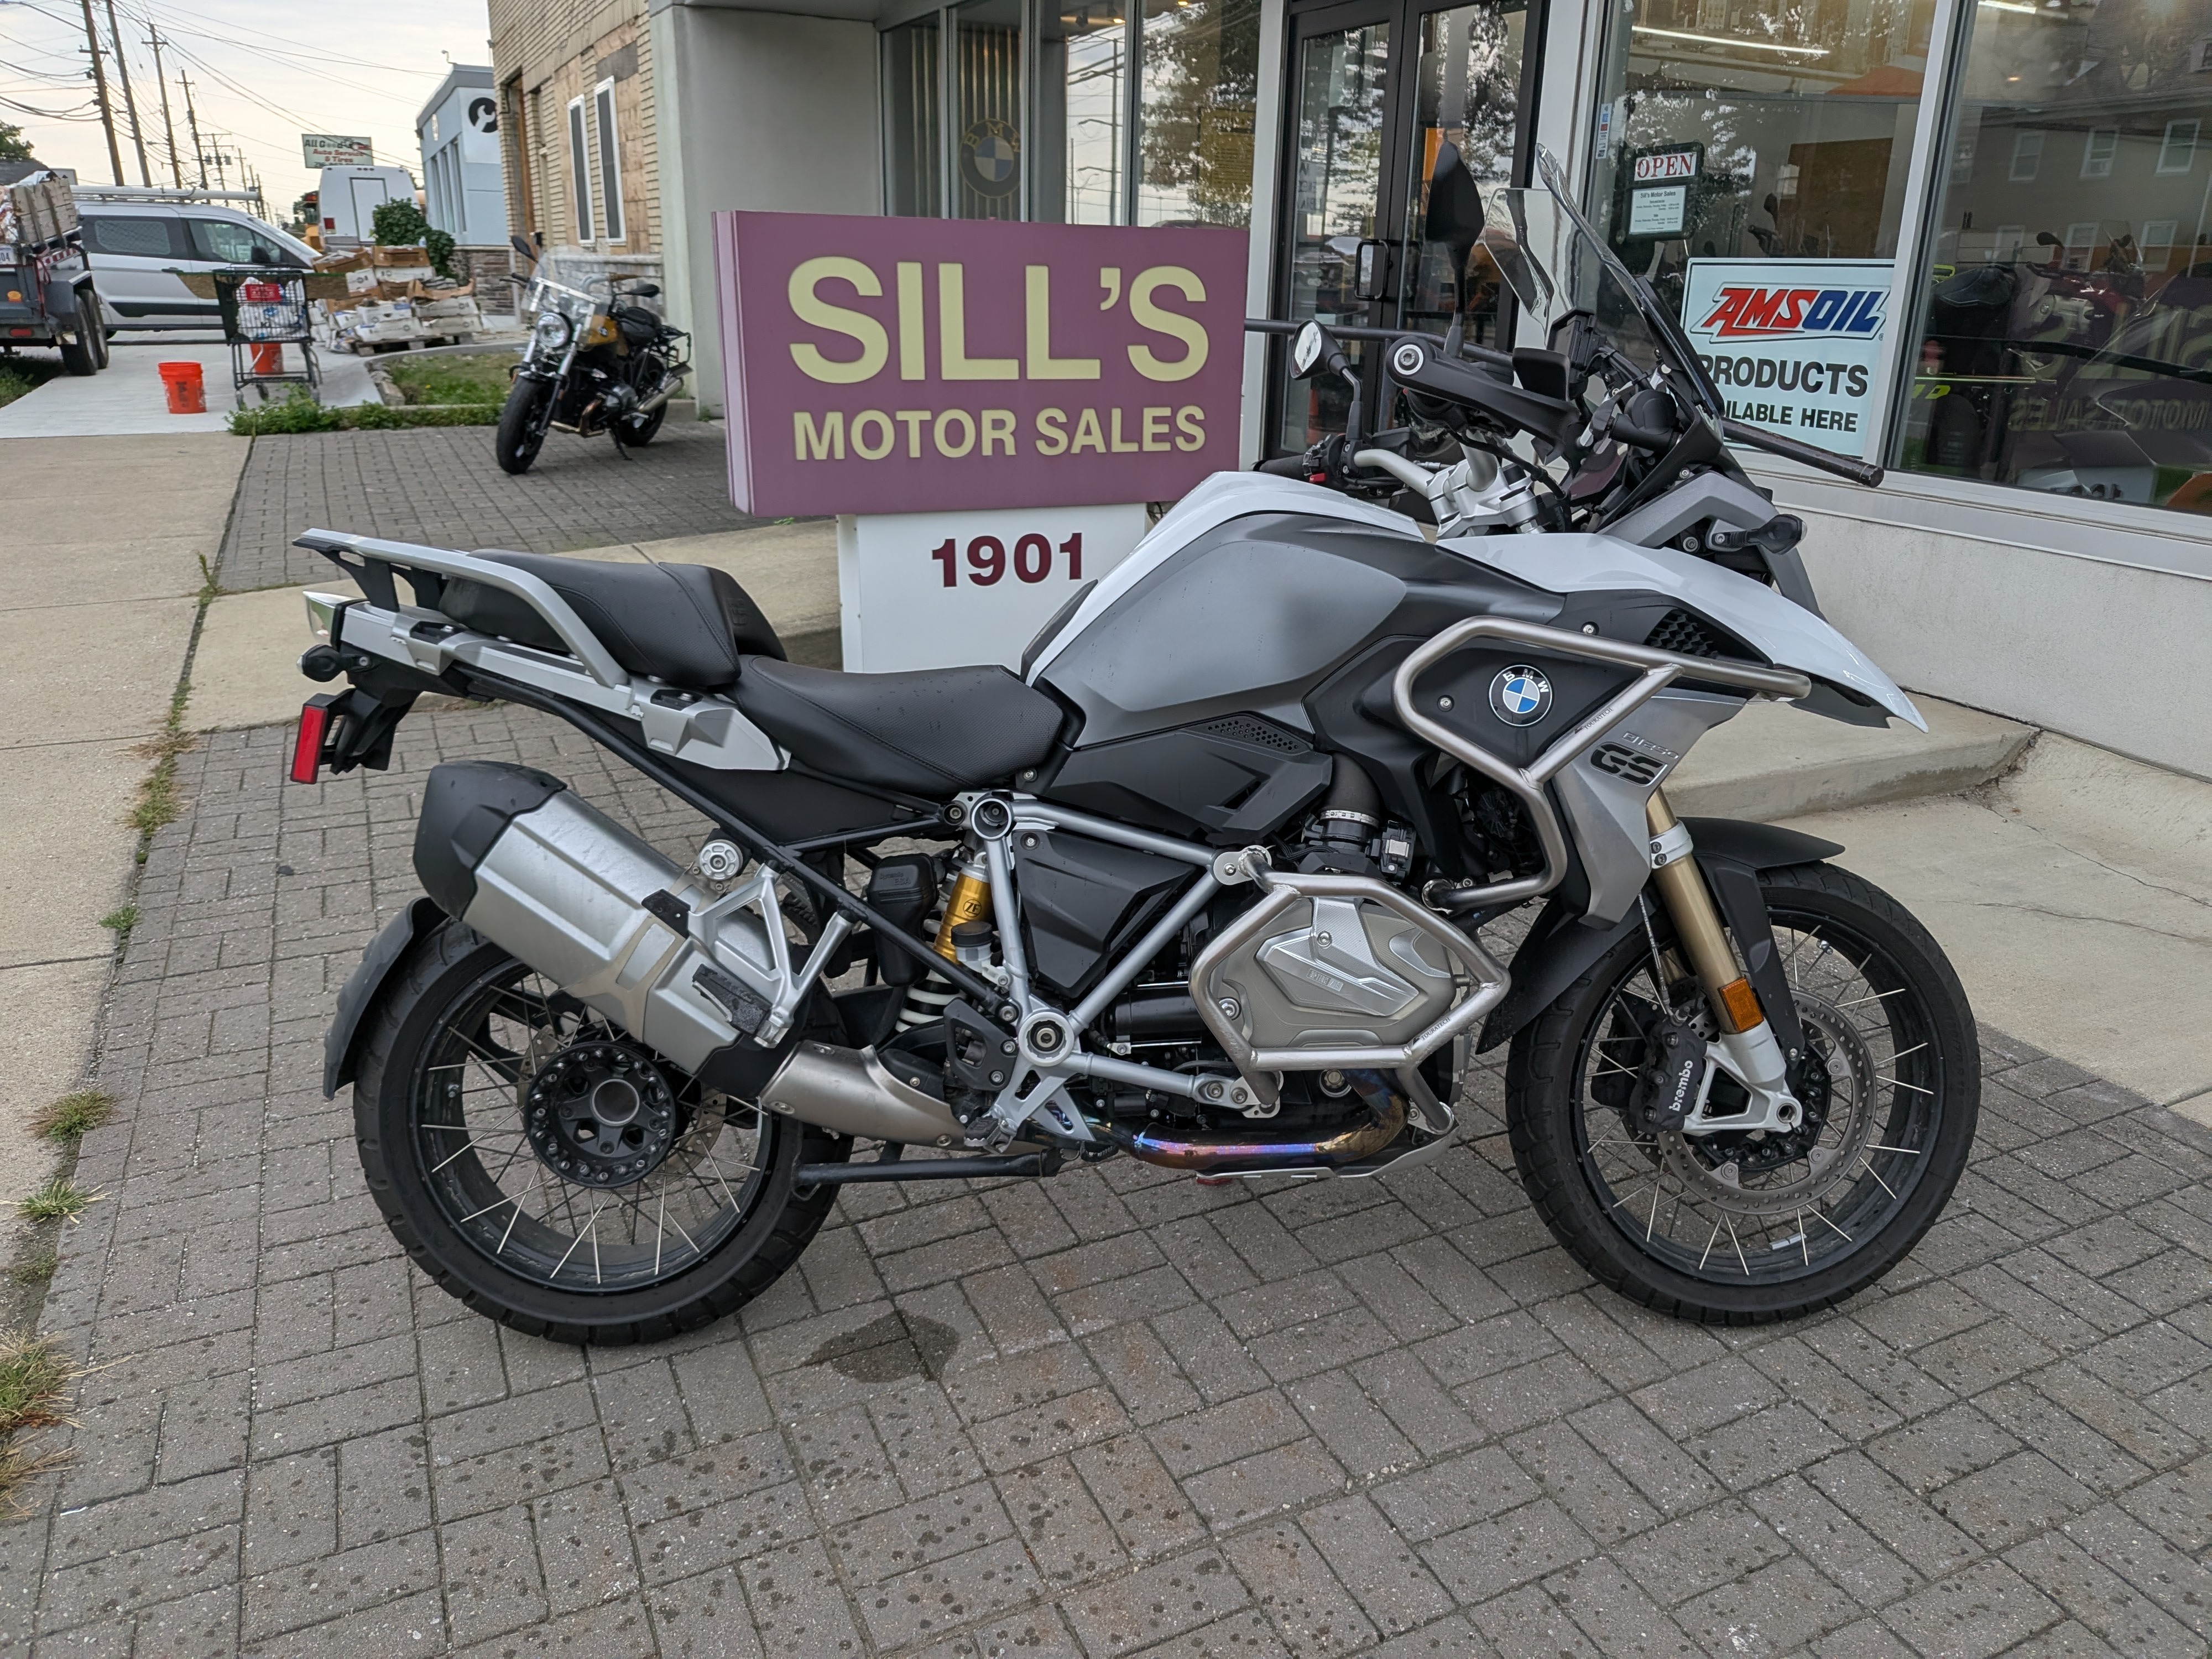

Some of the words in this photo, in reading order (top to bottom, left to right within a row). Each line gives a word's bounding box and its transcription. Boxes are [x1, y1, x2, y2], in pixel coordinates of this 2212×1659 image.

[1637, 154, 1694, 178] OPEN
[787, 255, 1210, 384] SILL'S
[1701, 287, 1884, 338] AMSOIL
[794, 409, 1018, 461] MOTOR
[1035, 404, 1207, 454] SALES
[1725, 400, 1793, 425] ILABLE
[1800, 406, 1859, 433] HERE
[931, 531, 1083, 588] 1901
[1502, 668, 1549, 692] BMW
[1583, 707, 1614, 729] TOURATECH
[1590, 743, 1664, 785] GS
[964, 901, 982, 916] ZF
[1421, 1016, 1452, 1041] TOURATECH
[1668, 1060, 1693, 1112] brembo
